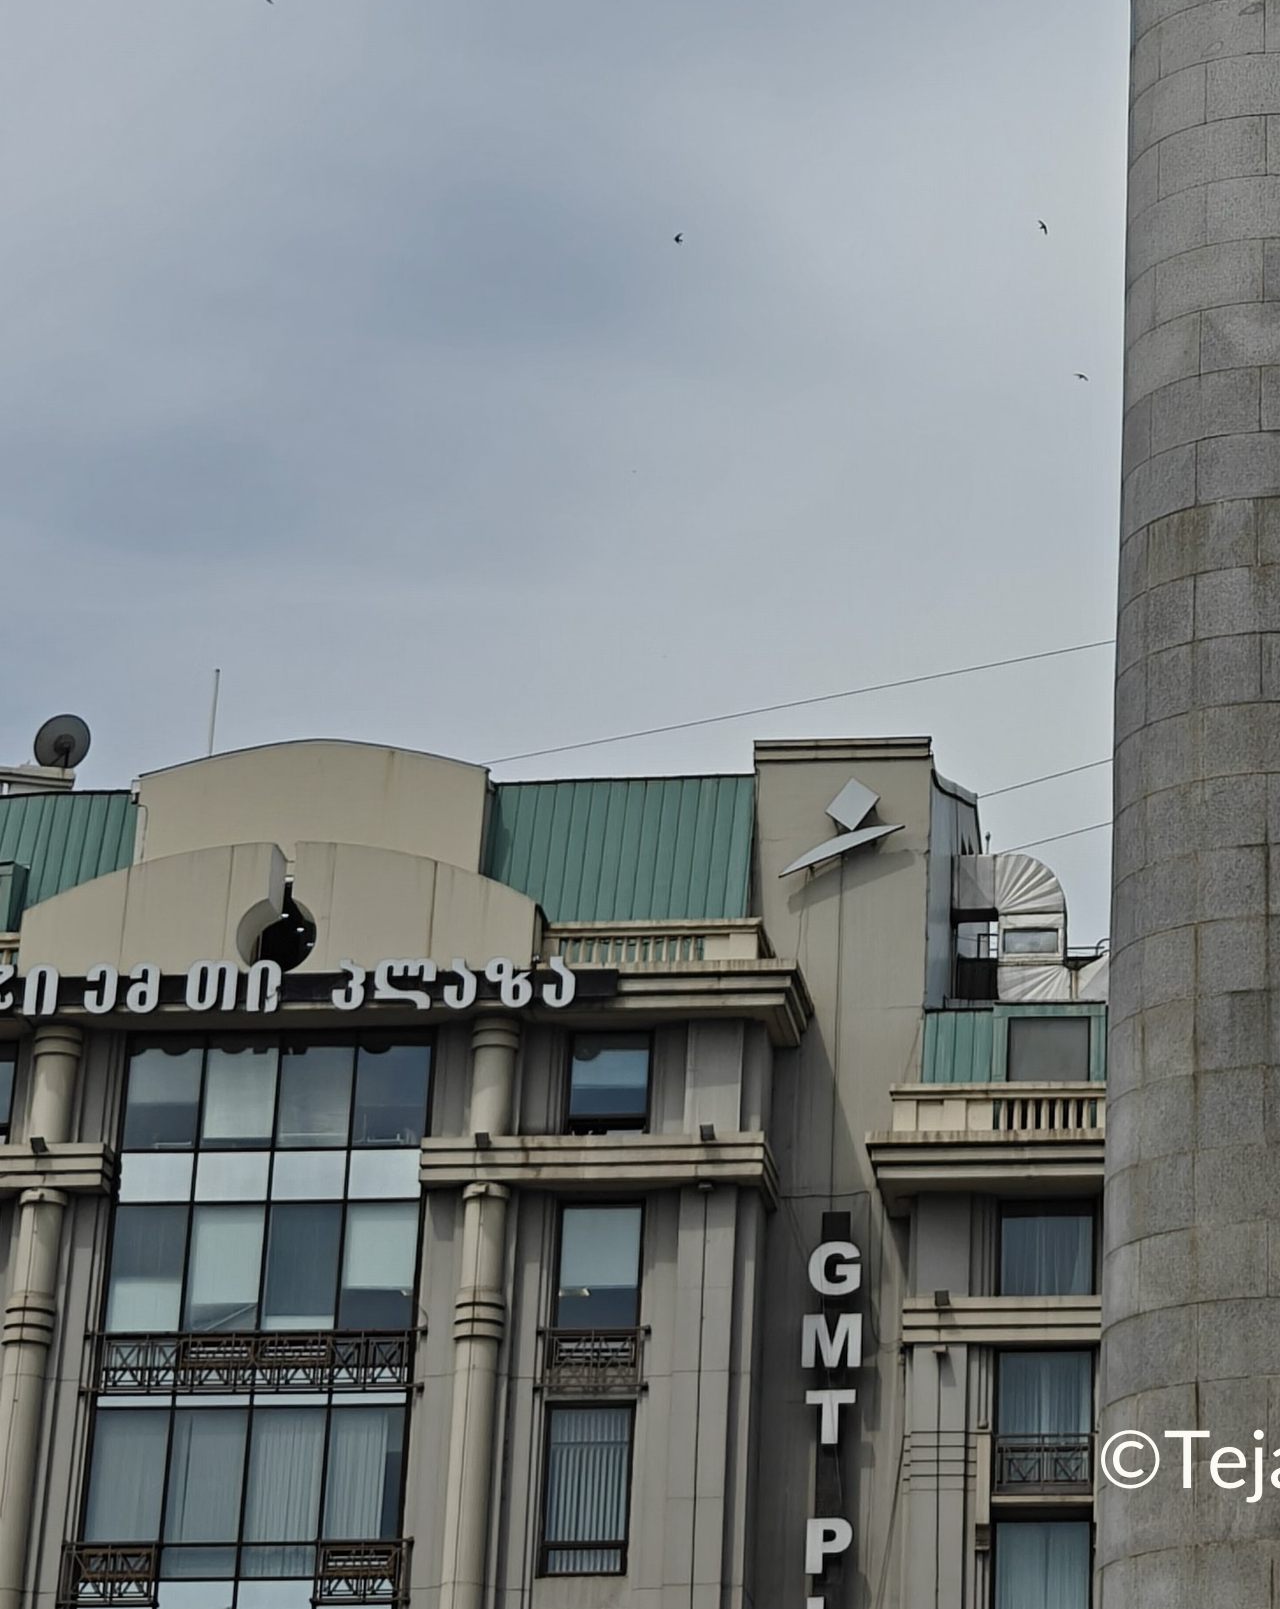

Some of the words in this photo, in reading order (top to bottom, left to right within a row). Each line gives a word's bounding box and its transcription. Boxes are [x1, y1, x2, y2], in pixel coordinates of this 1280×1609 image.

[83, 962, 161, 1014] ემ
[186, 959, 282, 1013] თი
[331, 955, 576, 1011] პლაზა
[801, 1240, 863, 1445] GMT
[804, 1517, 853, 1609] P
